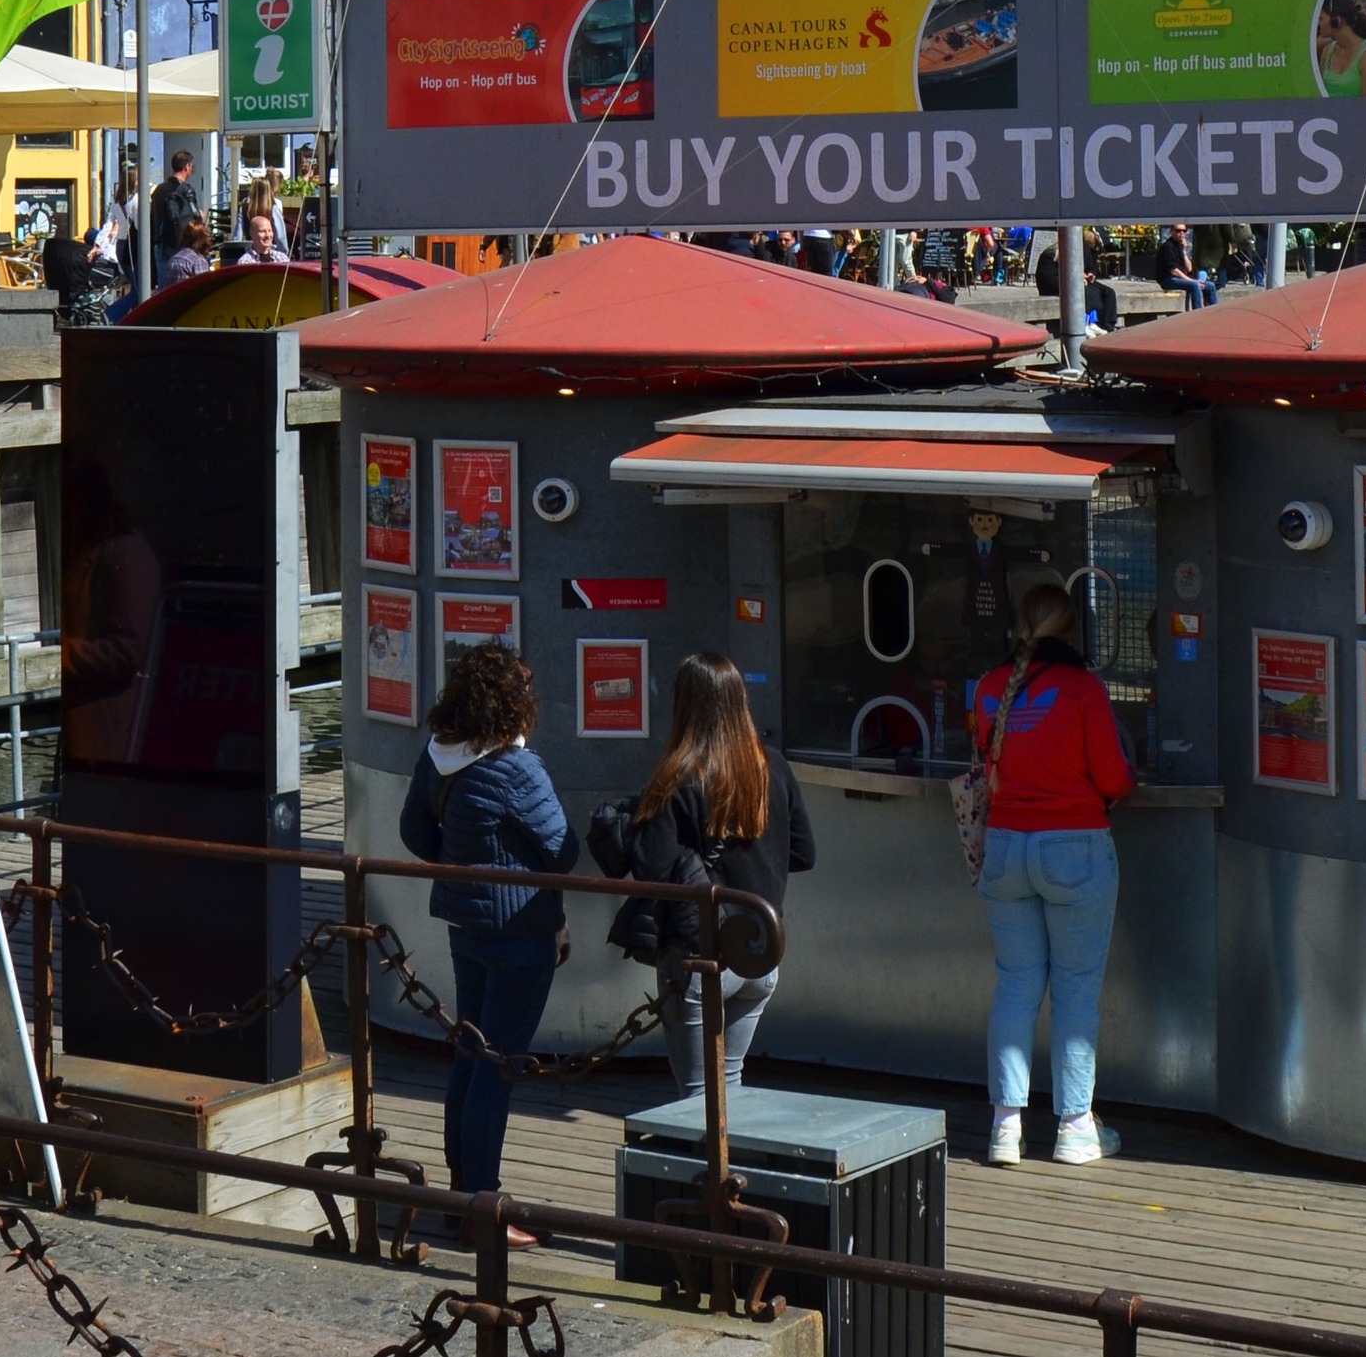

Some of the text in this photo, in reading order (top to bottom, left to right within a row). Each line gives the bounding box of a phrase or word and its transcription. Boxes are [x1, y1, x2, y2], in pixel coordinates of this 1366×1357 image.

[730, 18, 848, 36] CANAL TOURS
[1169, 30, 1218, 38] COPENHAGEN
[728, 36, 849, 53] COPENHAGEN
[756, 60, 867, 81] Sightseeing by boat
[1097, 58, 1121, 76] Hop
[1125, 60, 1140, 72] on
[1154, 56, 1178, 74] Hop
[1182, 54, 1199, 71] off
[1203, 53, 1226, 70] bus
[1229, 52, 1253, 69] and
[1257, 51, 1287, 68] boat
[420, 76, 443, 90] Hop
[446, 77, 459, 88] on
[471, 74, 494, 90] Hop
[497, 73, 513, 86] off
[517, 72, 537, 86] bus
[233, 93, 310, 111] TOURIST
[587, 136, 736, 208] BUY
[758, 130, 981, 206] YOUR
[1003, 118, 1343, 201] TICKETS
